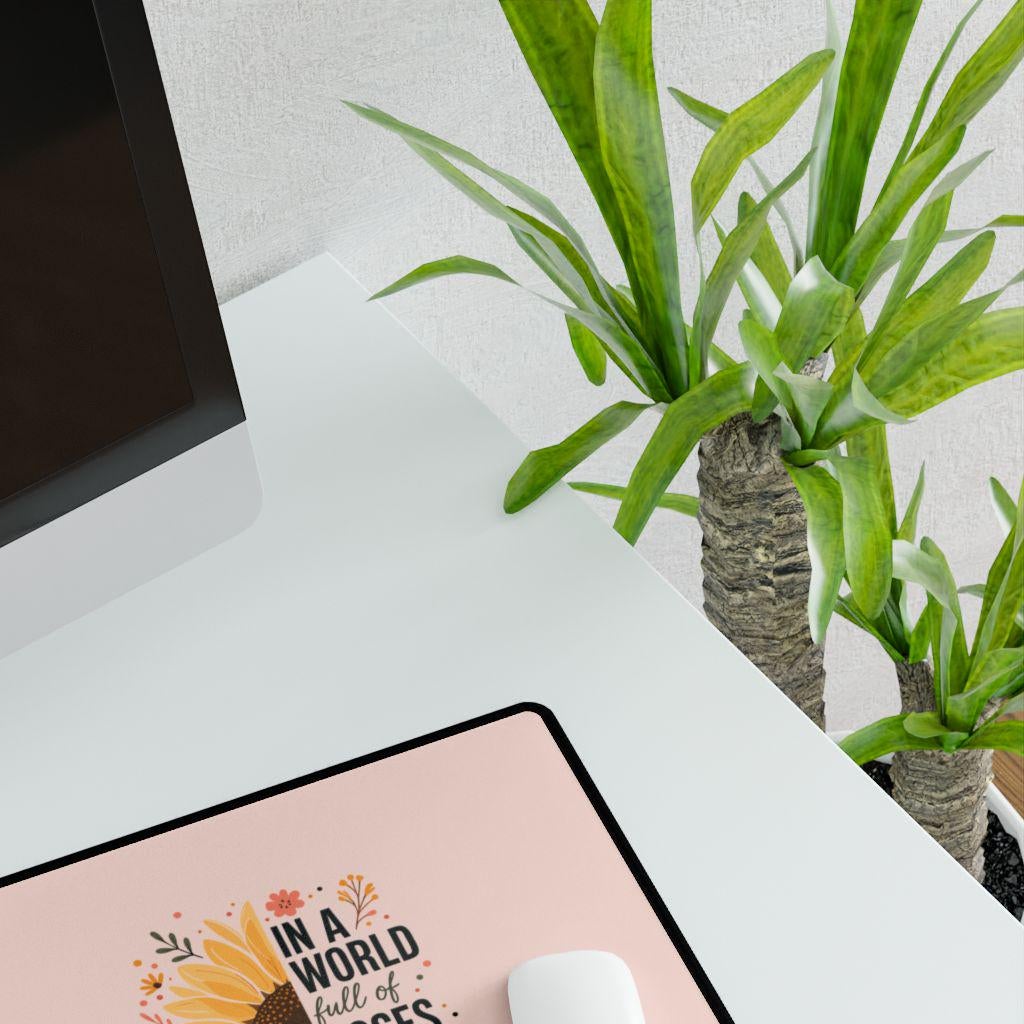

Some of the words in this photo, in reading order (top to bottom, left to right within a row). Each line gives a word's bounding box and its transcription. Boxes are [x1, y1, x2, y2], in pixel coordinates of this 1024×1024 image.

[270, 917, 316, 959] IN
[319, 907, 351, 943] A
[288, 924, 420, 994] WORLD
[375, 971, 401, 1003] of
